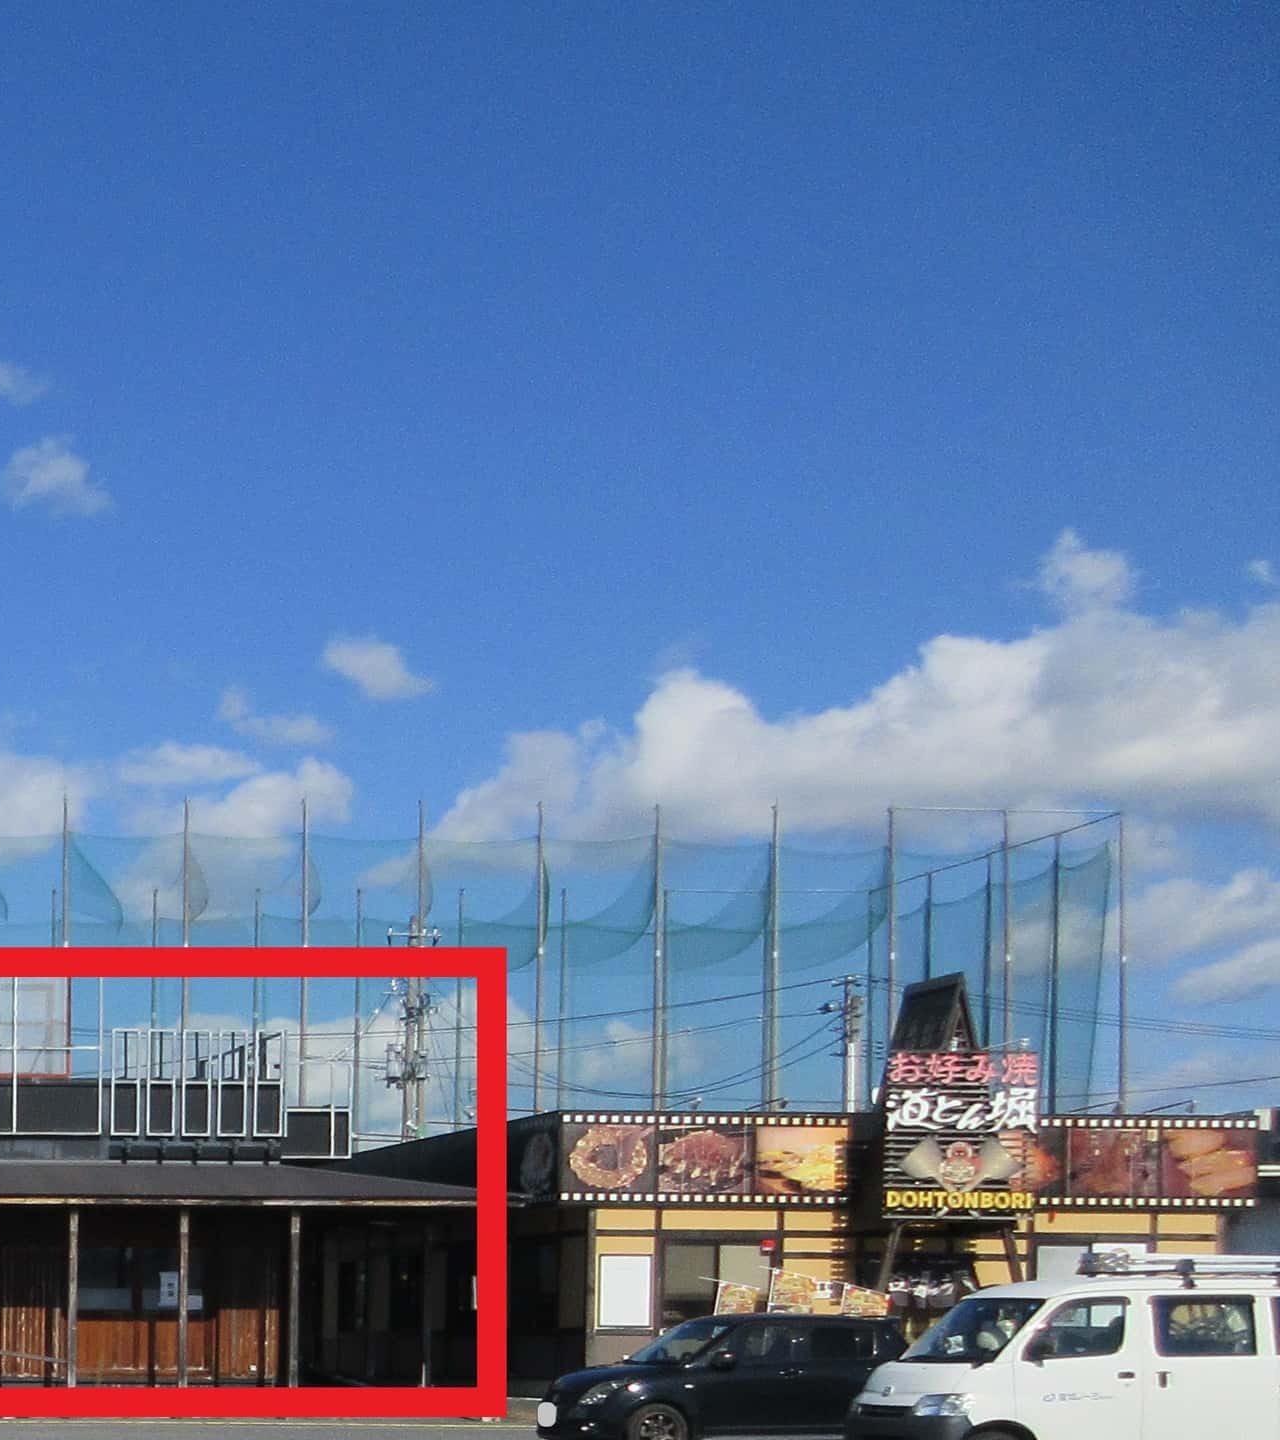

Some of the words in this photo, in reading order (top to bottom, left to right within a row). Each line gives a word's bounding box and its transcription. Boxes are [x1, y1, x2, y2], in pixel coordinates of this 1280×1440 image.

[889, 1053, 1038, 1085] お好み焼
[885, 1087, 1038, 1134] 道とん堀
[886, 1190, 1035, 1209] DOHTONBORI
